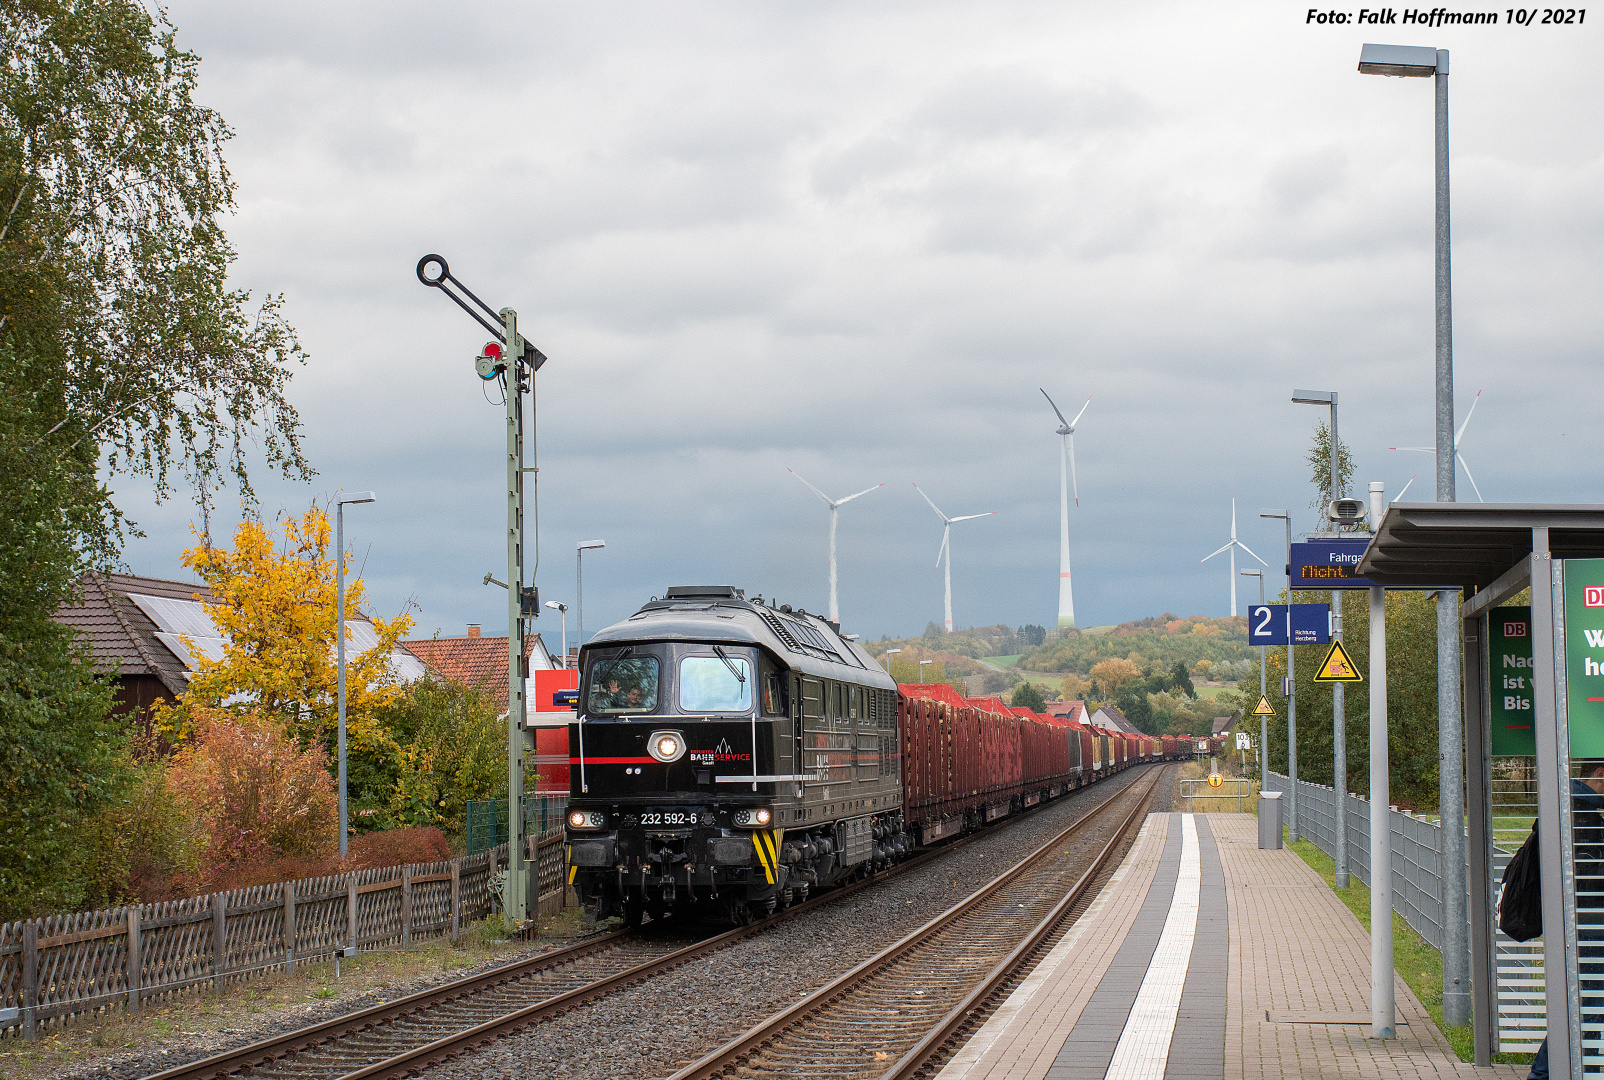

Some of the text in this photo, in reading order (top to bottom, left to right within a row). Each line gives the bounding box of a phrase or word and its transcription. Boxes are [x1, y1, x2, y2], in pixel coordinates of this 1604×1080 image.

[1587, 588, 1604, 605] D
[1254, 606, 1272, 636] 2
[1505, 624, 1525, 636] DB
[1503, 675, 1525, 689] ist
[1504, 696, 1531, 710] Bis
[640, 813, 697, 824] 232 592-6
